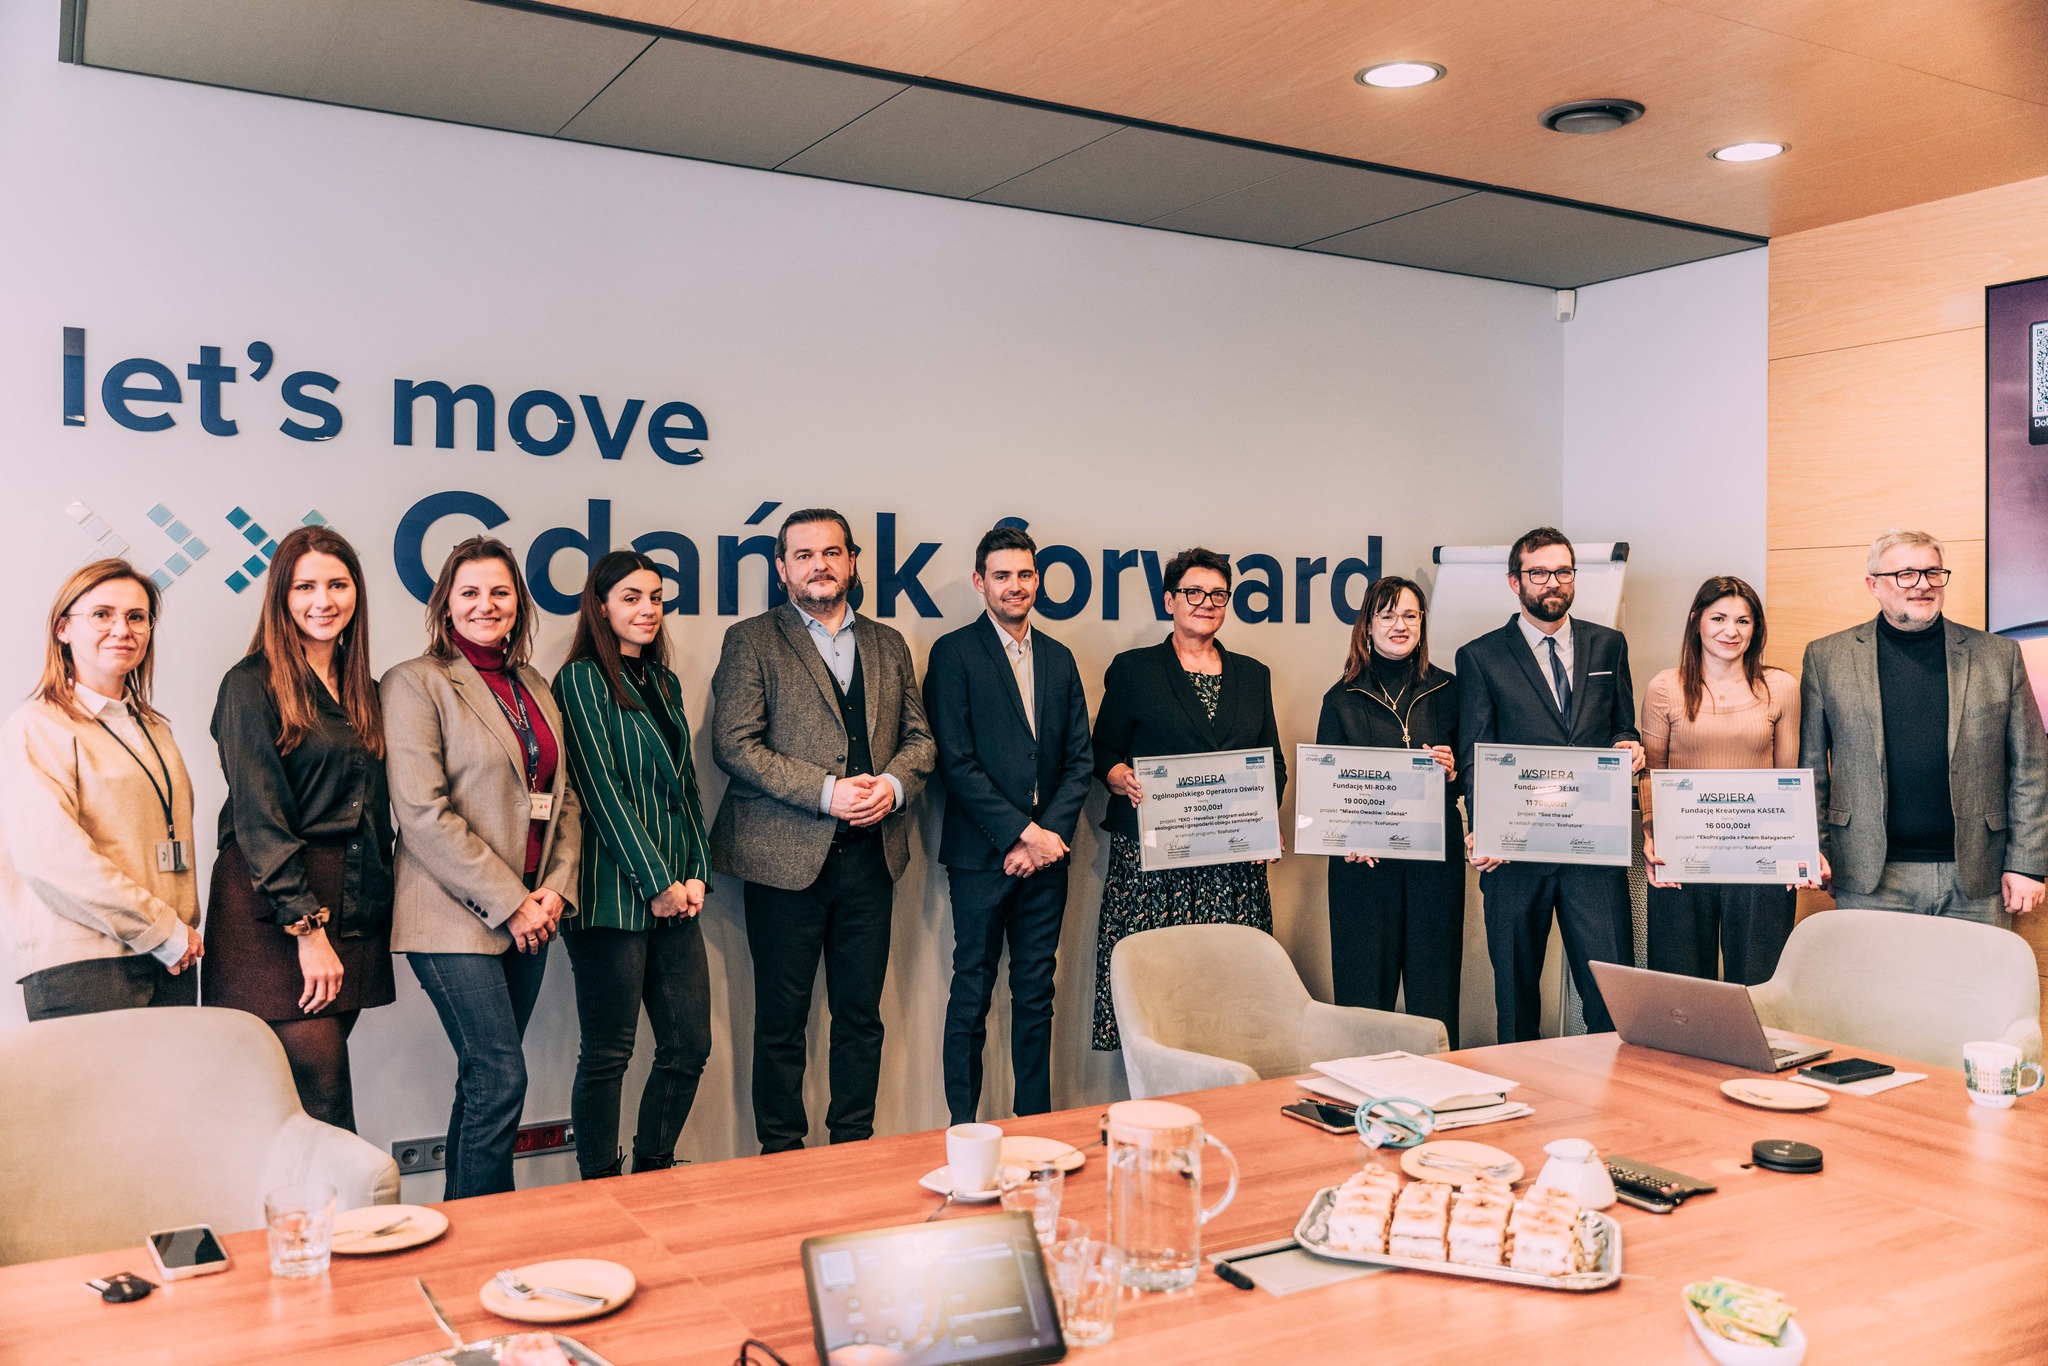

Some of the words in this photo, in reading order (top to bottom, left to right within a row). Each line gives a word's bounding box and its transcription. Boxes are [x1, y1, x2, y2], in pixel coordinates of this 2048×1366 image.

[393, 378, 709, 466] move
[393, 490, 943, 619] Gdańk
[993, 516, 1383, 625] orard
[1340, 768, 1391, 780] WSPIERA
[1521, 769, 1574, 780] WSPIERA
[1178, 774, 1226, 786] WSPIERA
[1333, 783, 1363, 791] Fundację
[1152, 791, 1205, 801] Ogólnopolskiego
[1206, 788, 1238, 797] Operatora
[1239, 785, 1265, 793] Oświaty
[1699, 793, 1755, 802] WSPIERA
[1353, 798, 1385, 806] 000,00zł
[1193, 804, 1223, 813] 300,00zł
[1681, 807, 1713, 815] Fundację
